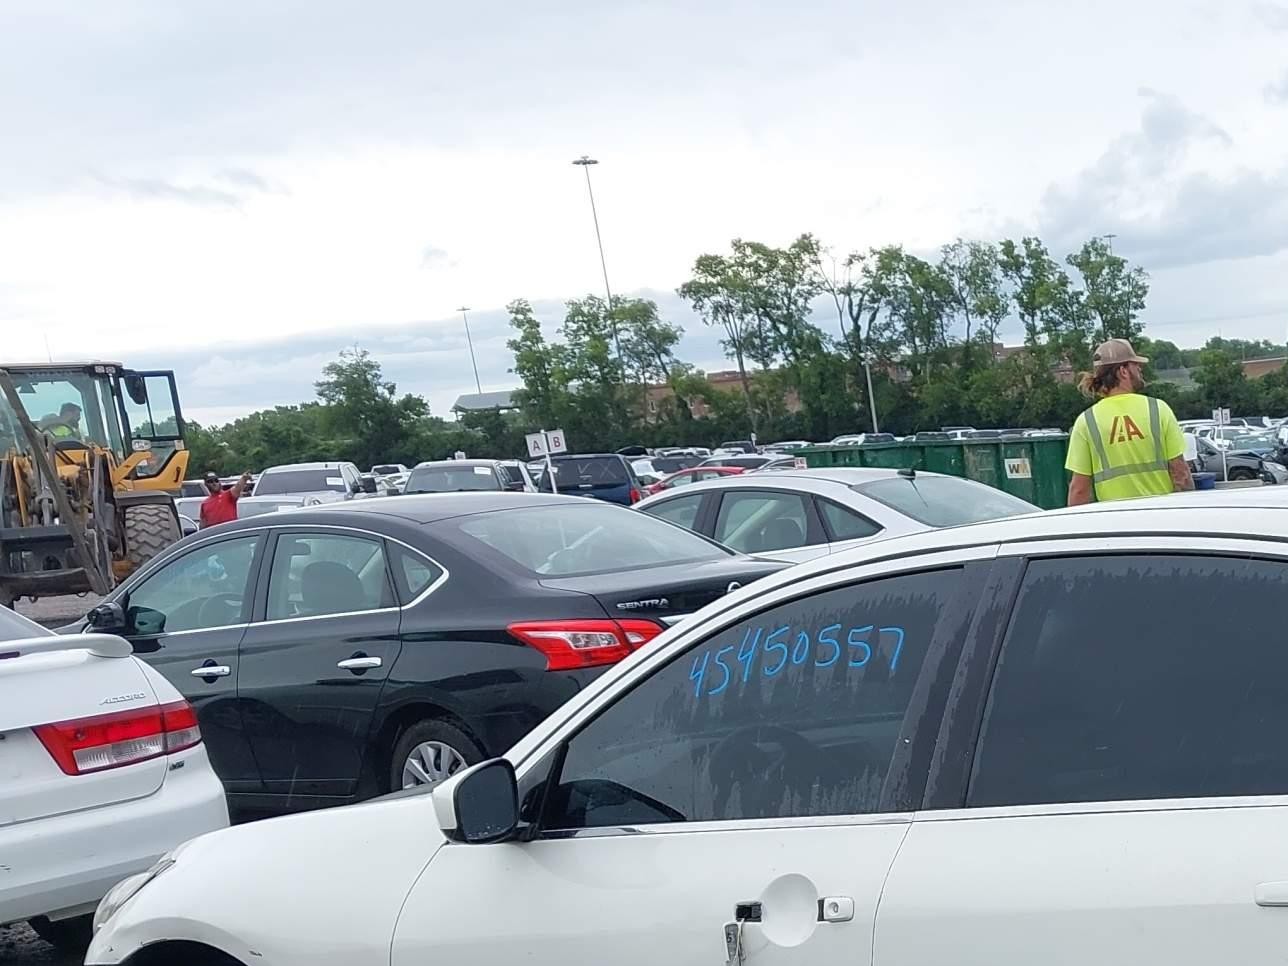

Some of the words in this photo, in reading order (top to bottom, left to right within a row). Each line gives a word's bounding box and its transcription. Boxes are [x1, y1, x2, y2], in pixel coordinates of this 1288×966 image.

[533, 440, 541, 451] A
[552, 436, 561, 448] B
[616, 598, 669, 609] SENTRA
[688, 623, 906, 698] 45450557
[99, 692, 147, 706] ACCORD
